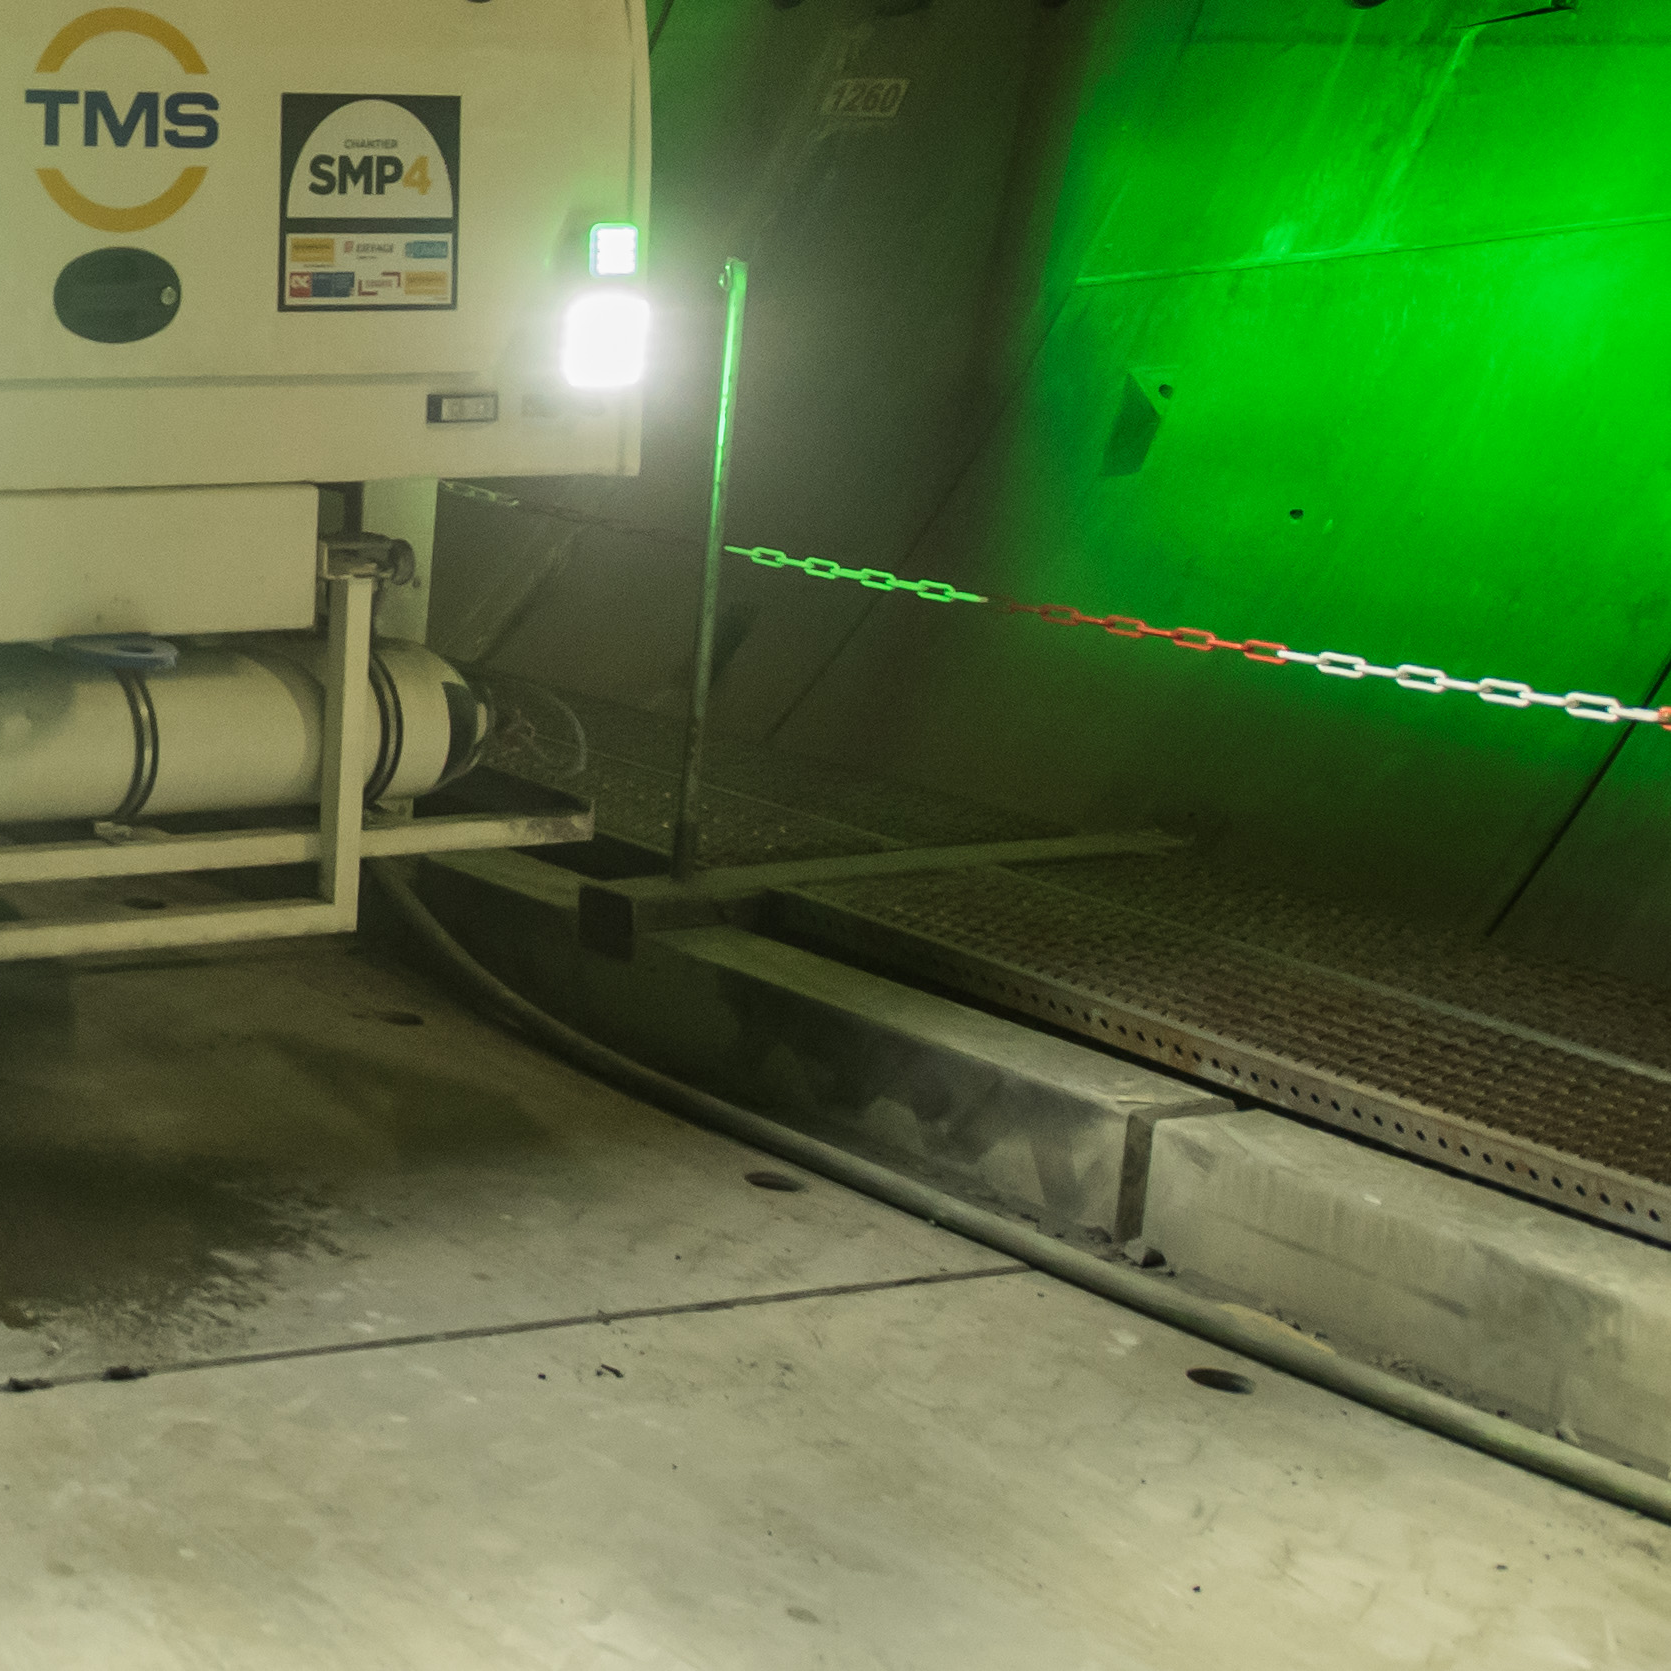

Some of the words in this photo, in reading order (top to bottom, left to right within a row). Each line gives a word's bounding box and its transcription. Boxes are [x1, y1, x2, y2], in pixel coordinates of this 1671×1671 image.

[831, 82, 902, 113] 1260
[25, 89, 220, 149] TMS
[344, 138, 398, 149] CHANTIER
[309, 154, 431, 195] SMP4
